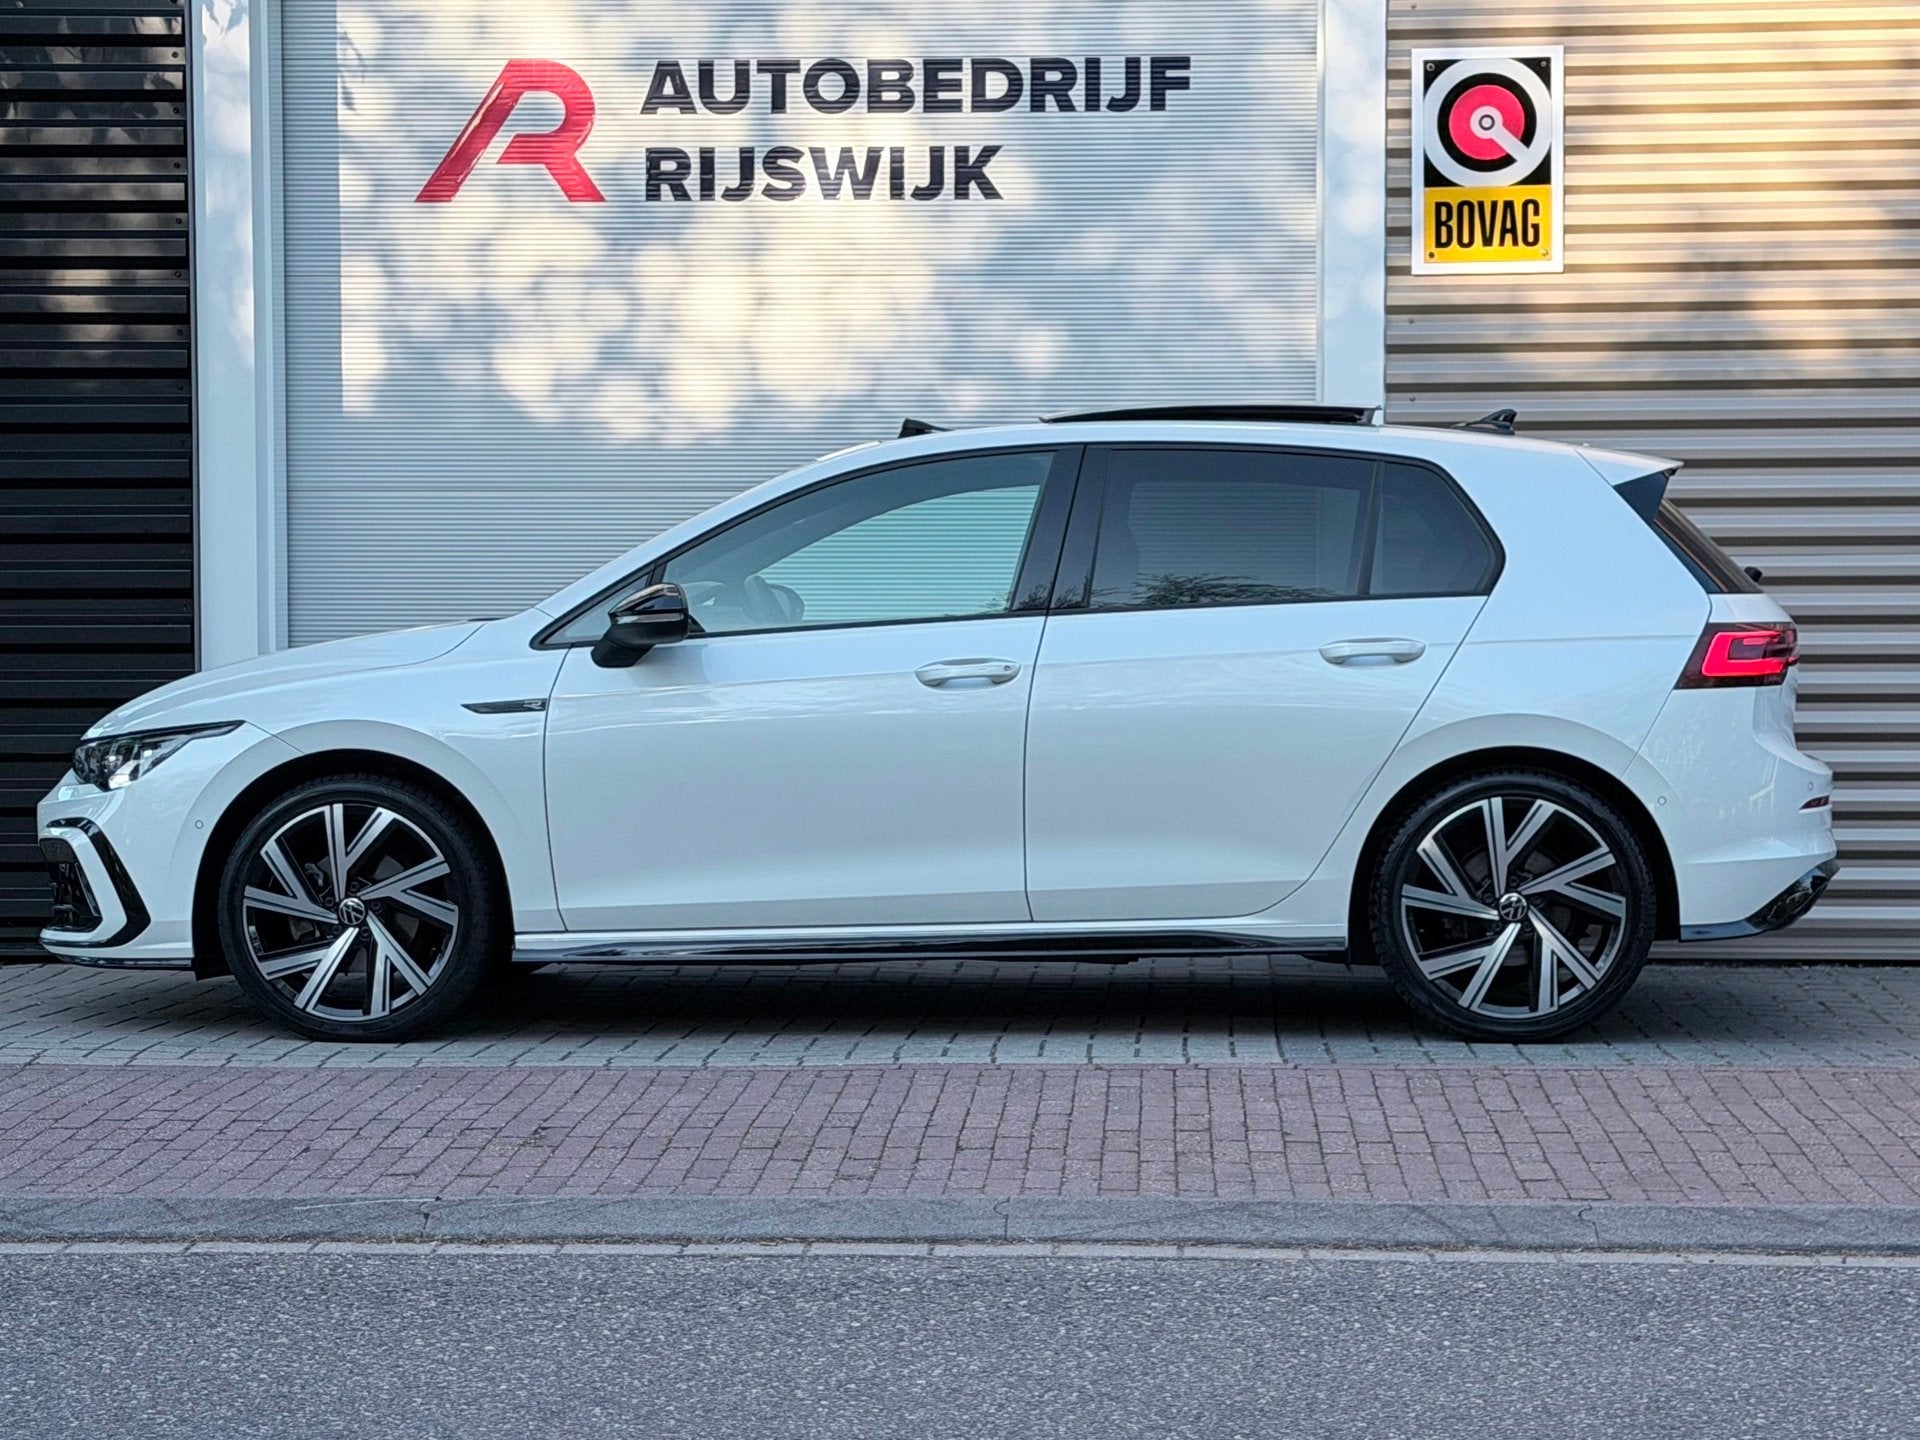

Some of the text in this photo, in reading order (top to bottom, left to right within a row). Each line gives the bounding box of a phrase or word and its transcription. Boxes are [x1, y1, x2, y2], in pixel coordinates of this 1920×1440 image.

[640, 57, 1192, 115] AUTOBEDRIJF
[646, 145, 1003, 202] RIJSWIJK
[1434, 199, 1541, 249] BOVAG
